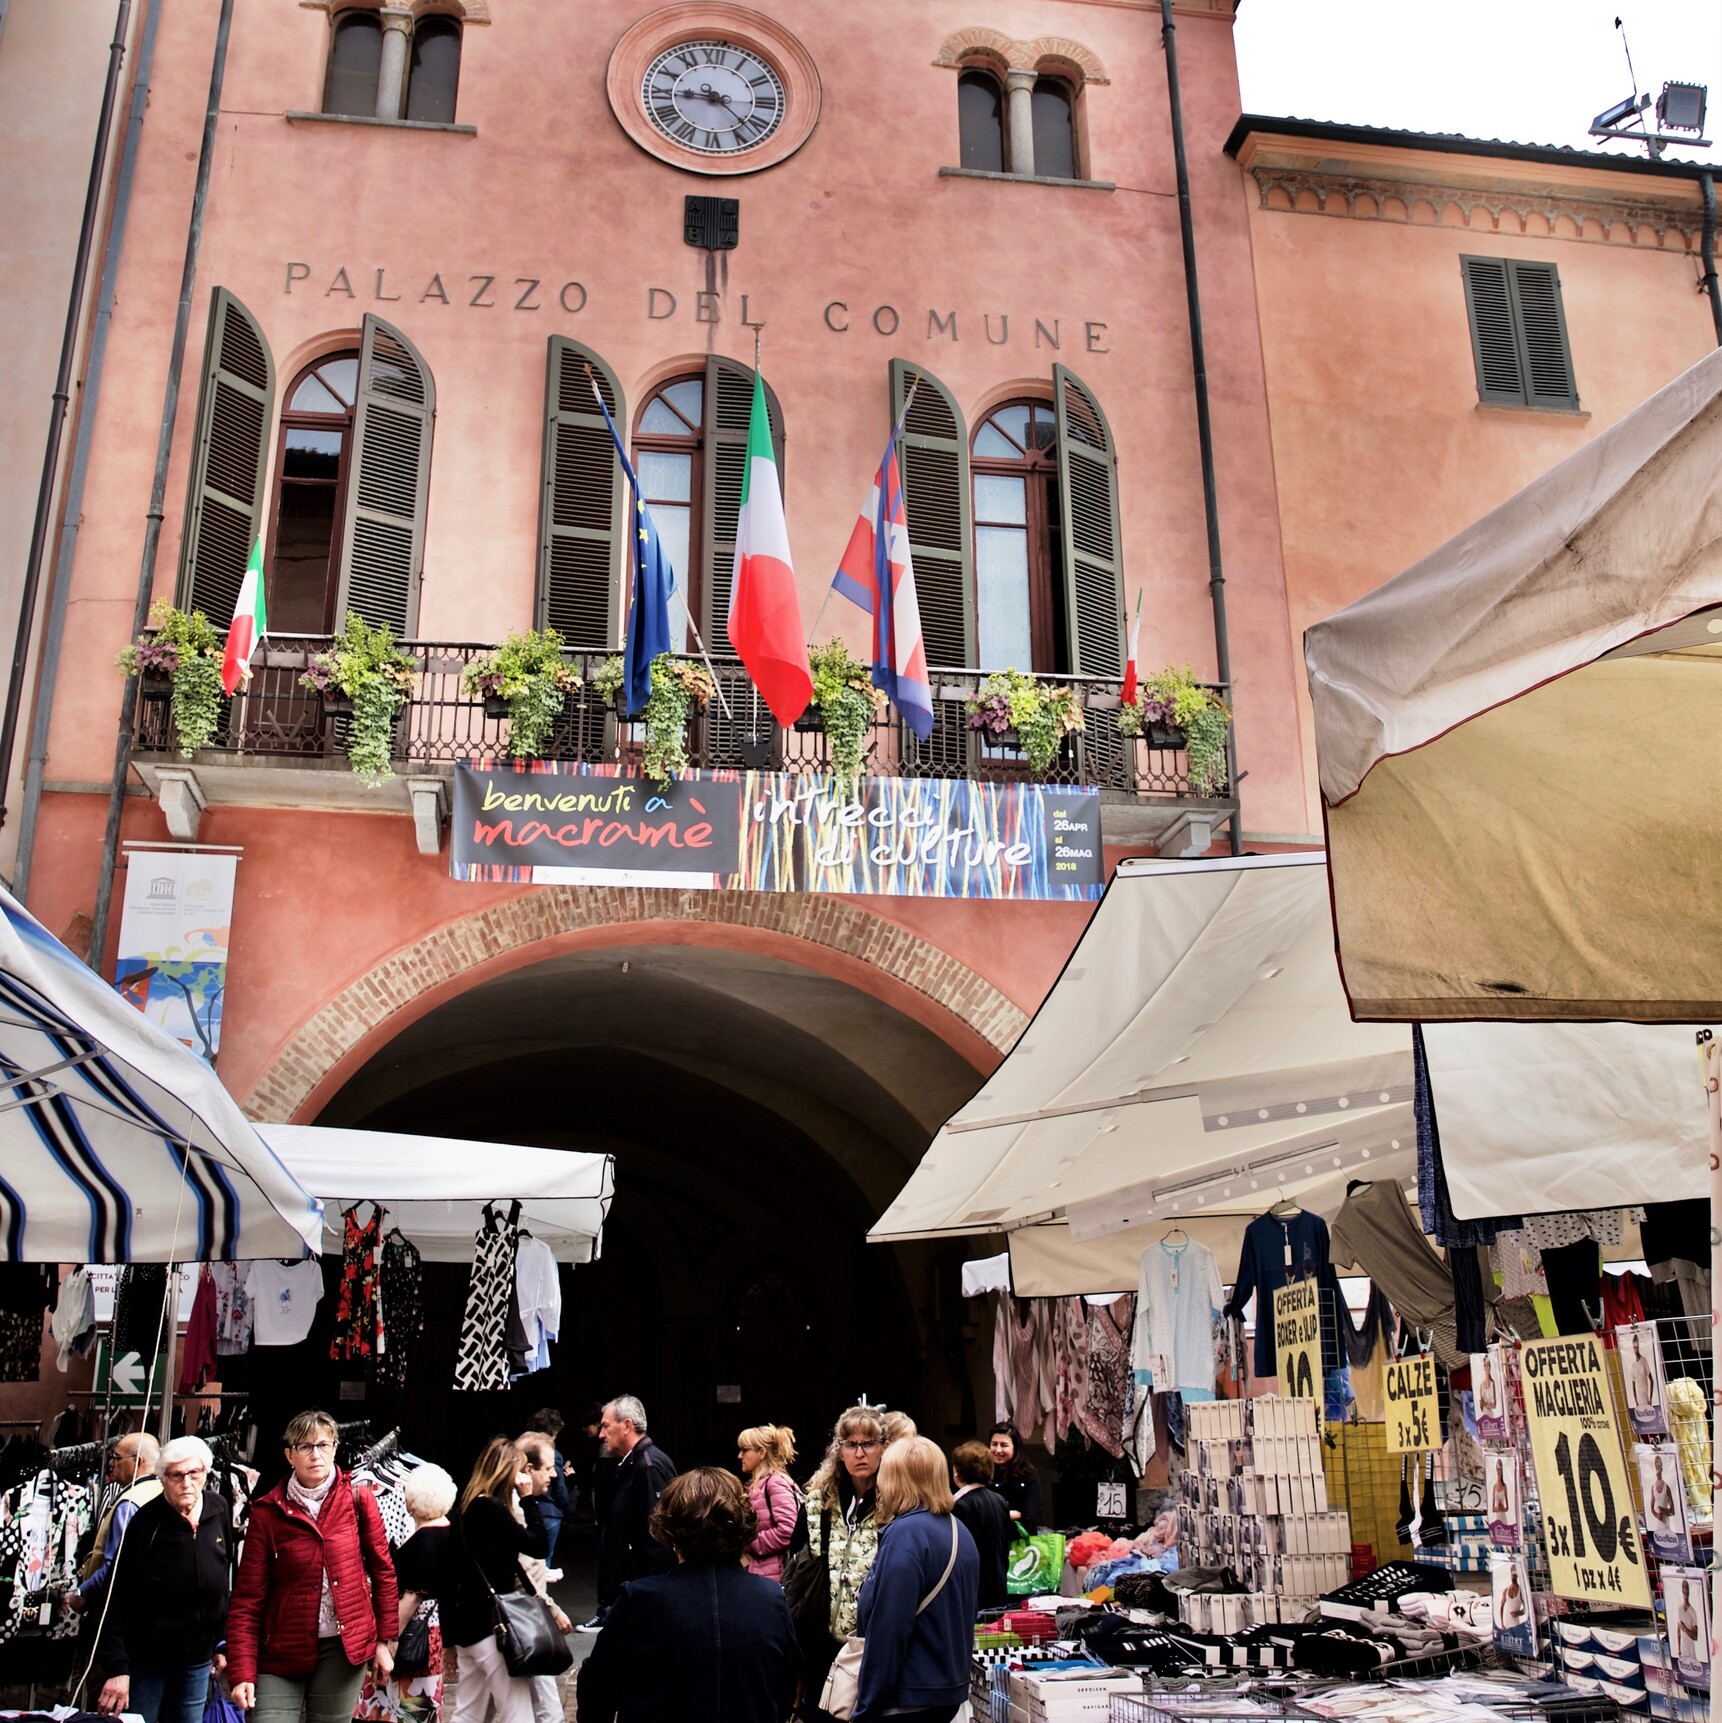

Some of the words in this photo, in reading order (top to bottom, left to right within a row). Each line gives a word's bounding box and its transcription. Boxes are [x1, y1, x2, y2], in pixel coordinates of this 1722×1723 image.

[702, 48, 726, 66] XII
[284, 262, 588, 313] PALAZZO
[647, 287, 767, 326] DEL
[824, 301, 1110, 353] COMUNE
[481, 779, 636, 815] benvenuti
[644, 796, 673, 813] a
[754, 786, 942, 828] intrecci
[1053, 810, 1067, 818] dal
[472, 797, 713, 848] macramè
[1054, 836, 1063, 844] al
[815, 826, 858, 867] di
[870, 826, 1032, 868] culture
[1055, 862, 1077, 871] 2018
[1276, 1285, 1315, 1317] OFFERTA
[1277, 1319, 1297, 1348] BOXER
[1298, 1325, 1303, 1343] e
[1525, 1341, 1601, 1378] OFFERTA
[1387, 1361, 1433, 1401] CALZE
[1533, 1377, 1605, 1417] MAGLIERIA
[1573, 1562, 1580, 1588] 1
[1581, 1568, 1597, 1591] pz
